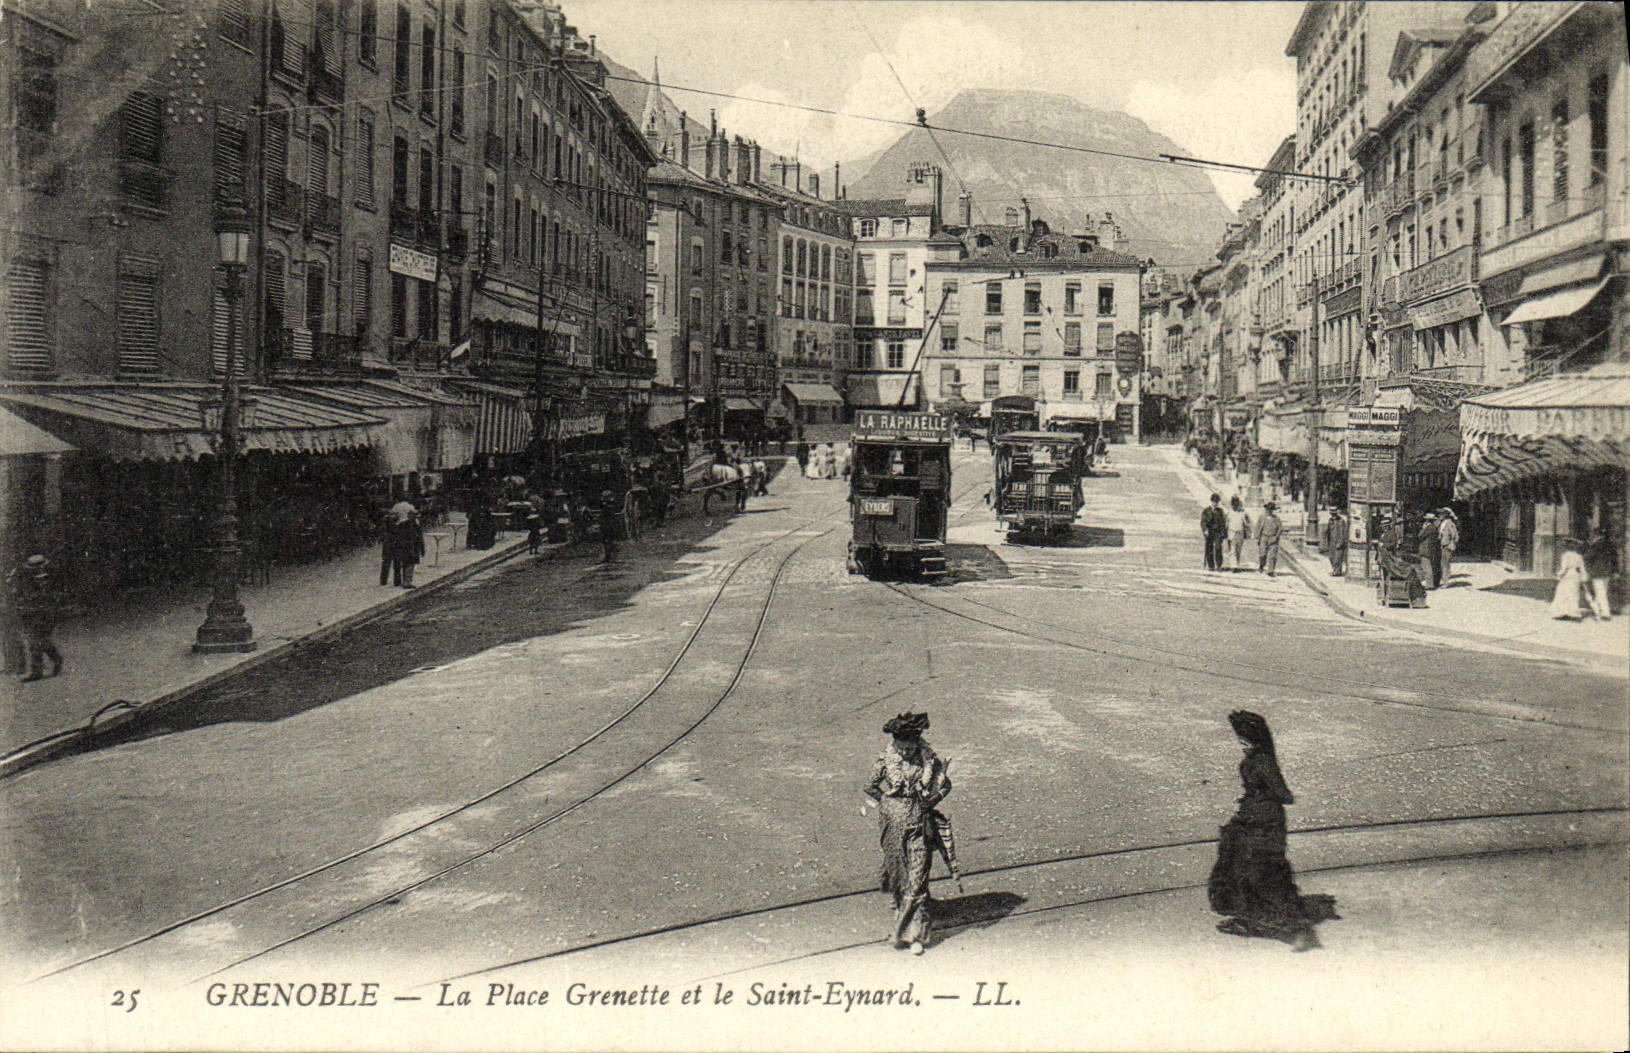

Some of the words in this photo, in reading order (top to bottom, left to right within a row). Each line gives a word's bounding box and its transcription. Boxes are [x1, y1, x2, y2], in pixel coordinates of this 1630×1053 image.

[859, 414, 874, 429] LA
[880, 415, 947, 431] RAPHAELLE
[1348, 411, 1368, 420] MAGGI
[1371, 412, 1398, 421] MAGGI
